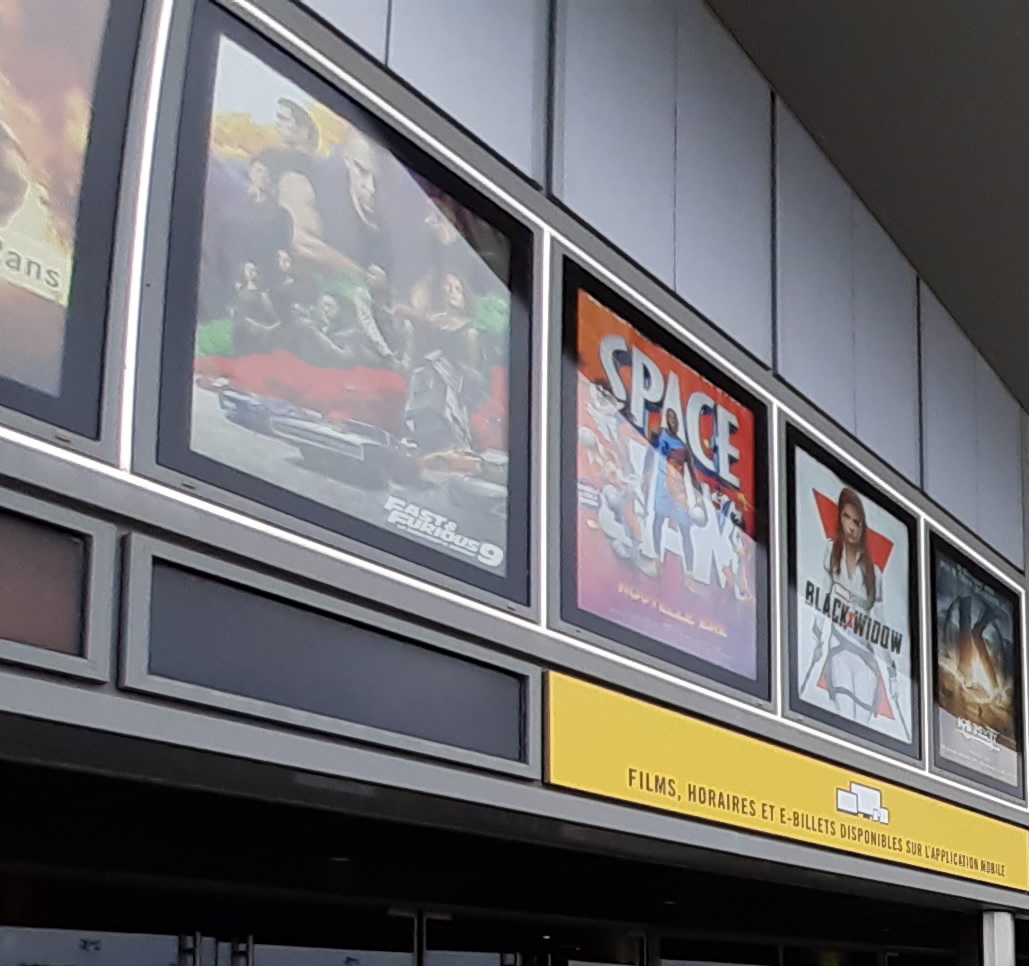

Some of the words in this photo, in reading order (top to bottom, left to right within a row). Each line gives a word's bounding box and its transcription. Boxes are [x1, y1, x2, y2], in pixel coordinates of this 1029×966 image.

[0, 239, 60, 288] ans
[600, 335, 740, 488] SPACE
[384, 496, 447, 526] FAST
[387, 509, 480, 553] FURIOUS
[477, 543, 504, 567] 9
[805, 580, 851, 630] BLACK
[853, 610, 903, 655] WIDOW
[628, 767, 682, 802] FILMS,
[687, 783, 756, 817] HORAIRES
[761, 802, 776, 822] ET
[779, 807, 836, 837] E-BILLETS
[840, 823, 903, 852] DISPONIBLES
[905, 840, 922, 857] SUR
[924, 845, 978, 871] L'APPLICATION
